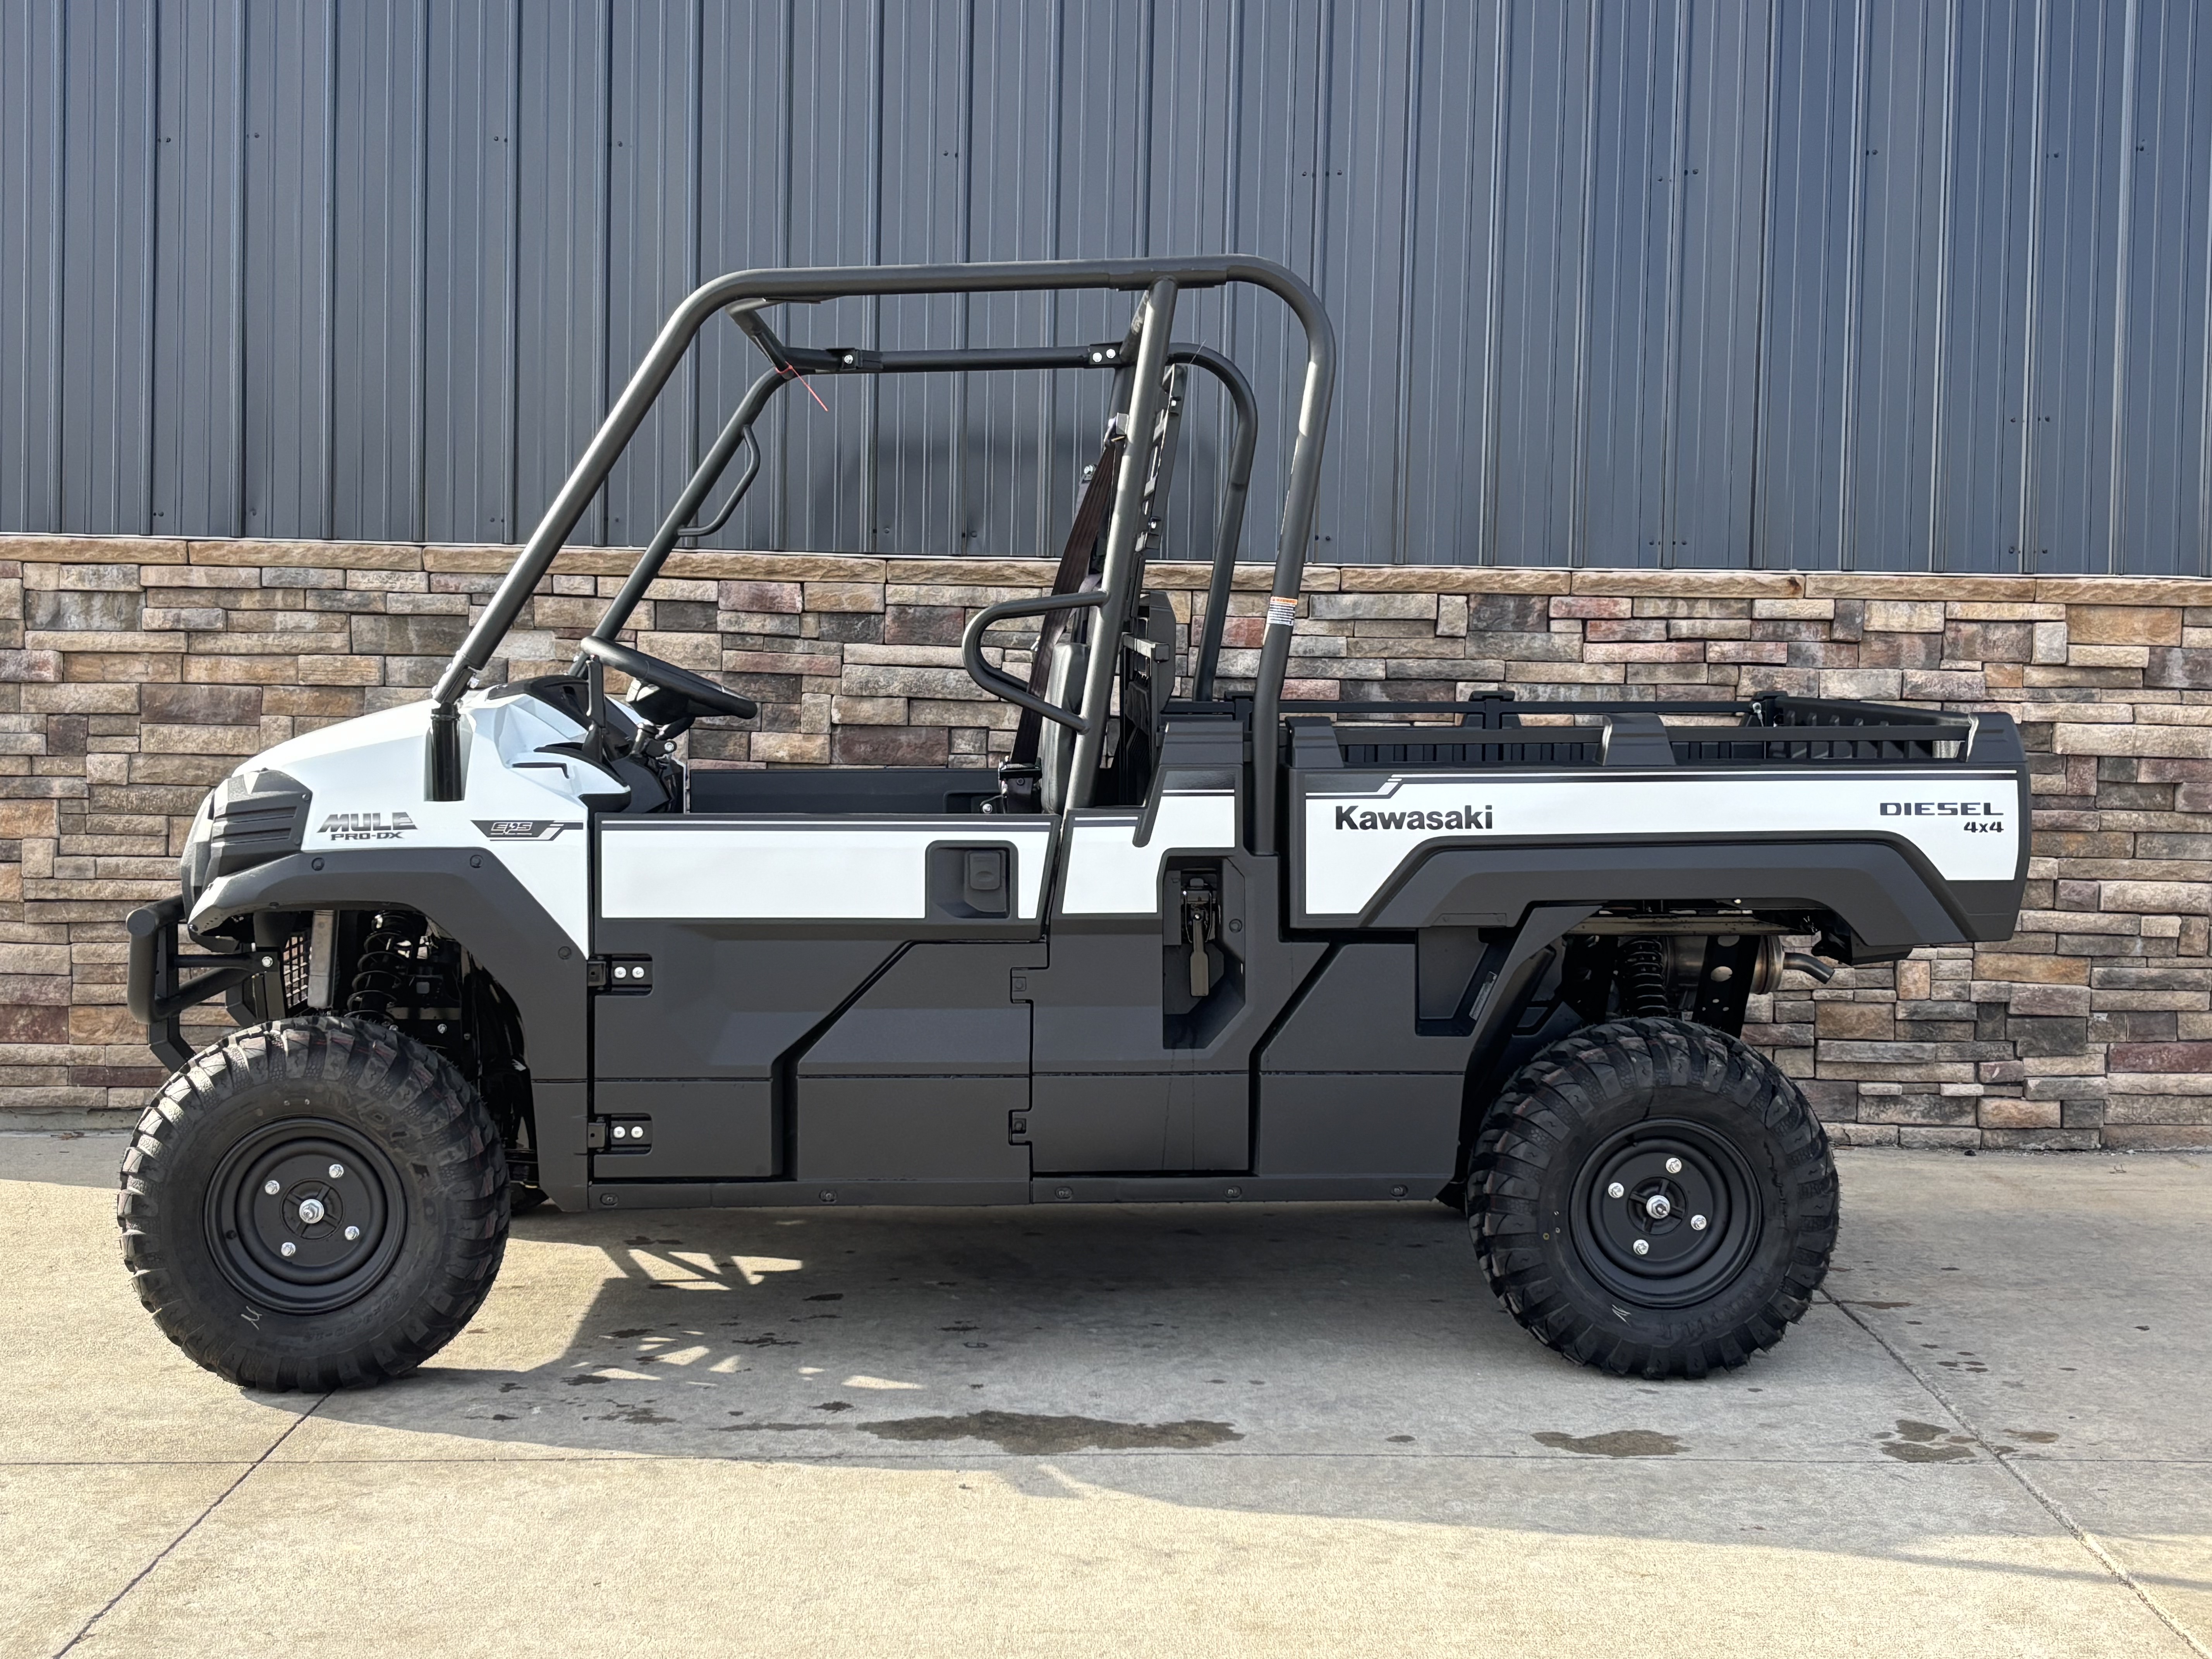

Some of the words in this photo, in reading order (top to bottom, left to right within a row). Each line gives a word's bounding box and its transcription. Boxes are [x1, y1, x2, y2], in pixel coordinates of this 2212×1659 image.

[1880, 802, 2004, 816] DIESEL
[316, 812, 418, 833] MULE
[1335, 805, 1492, 830] Kawasaki
[1963, 821, 2004, 833] 4x4
[331, 831, 405, 841] PRO-DX
